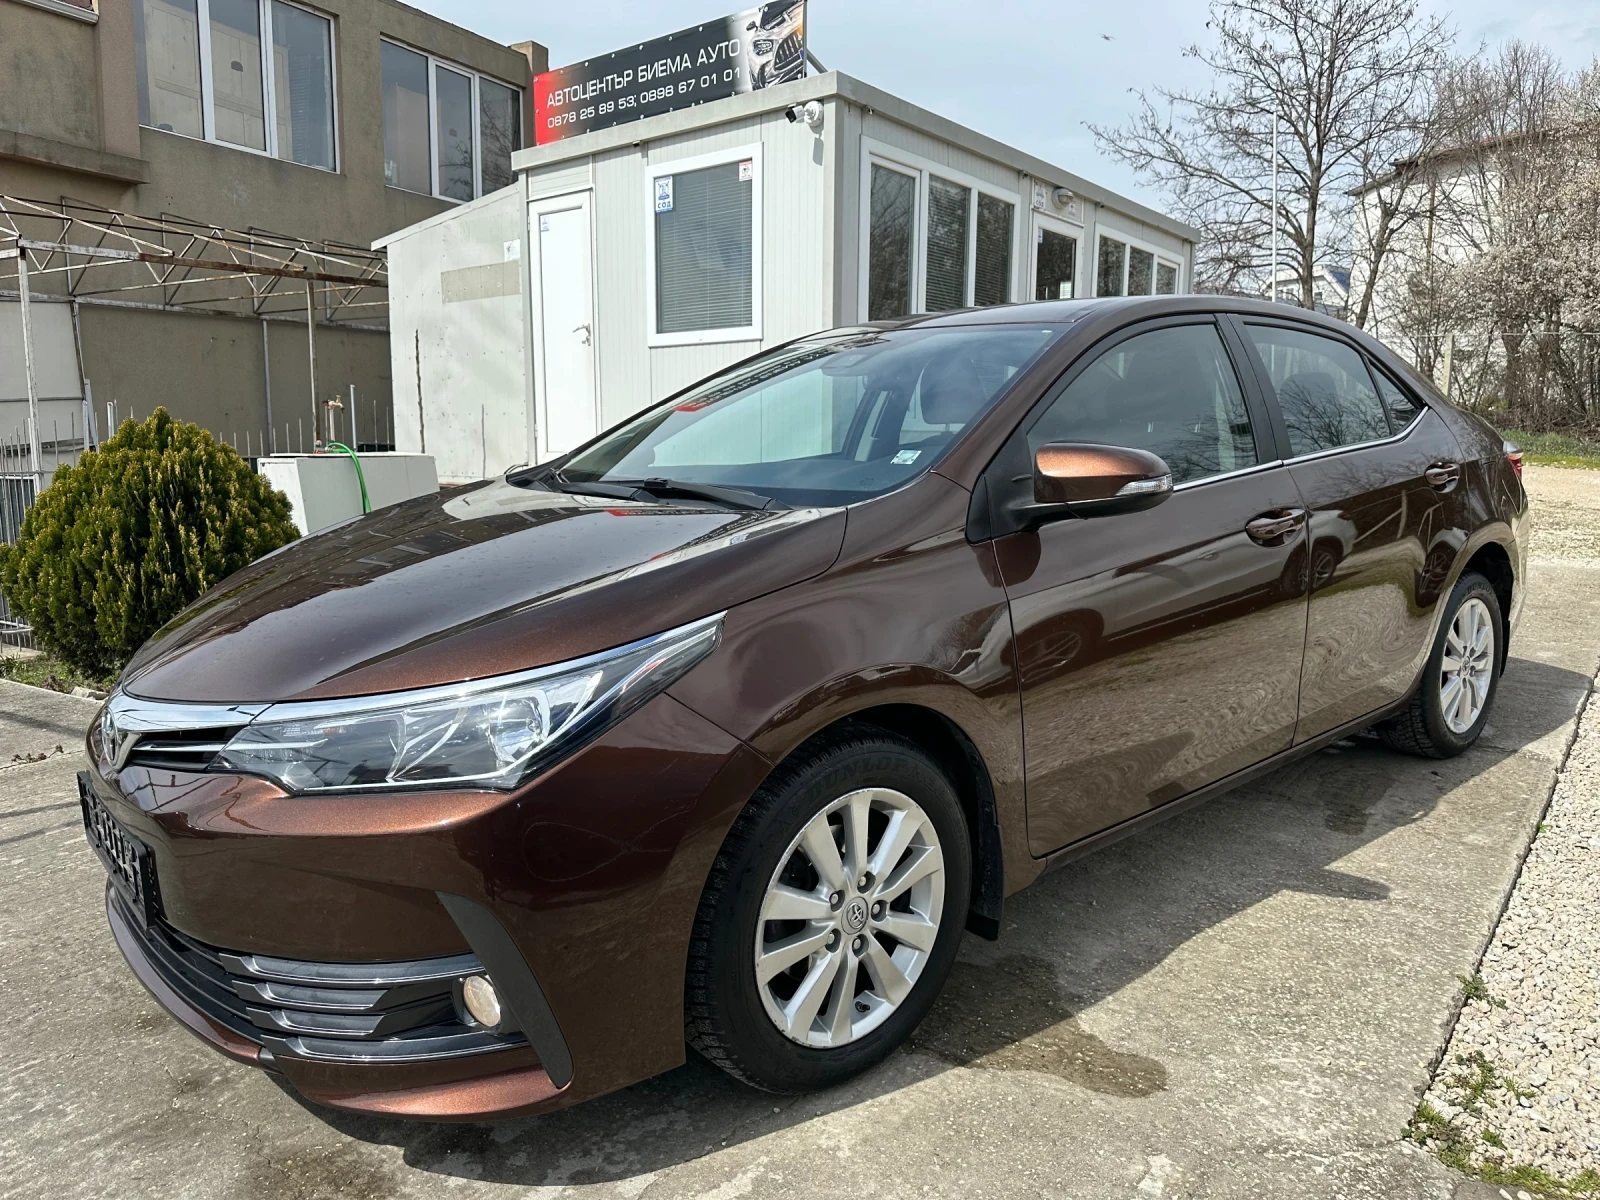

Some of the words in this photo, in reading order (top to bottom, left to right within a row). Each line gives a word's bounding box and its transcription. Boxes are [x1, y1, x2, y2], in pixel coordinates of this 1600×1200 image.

[546, 69, 634, 109] АВТОЦЕНТЪР
[637, 53, 692, 83] БИЕМА
[696, 38, 740, 67] АУТО
[547, 111, 576, 128] 0878
[579, 106, 595, 120] 25
[598, 101, 614, 115] 89
[618, 94, 637, 110] 53;
[640, 85, 674, 104] 0898
[678, 79, 696, 94] 67
[700, 73, 717, 88] 01
[723, 66, 740, 82] 01
[805, 757, 908, 800] DUNLOP
